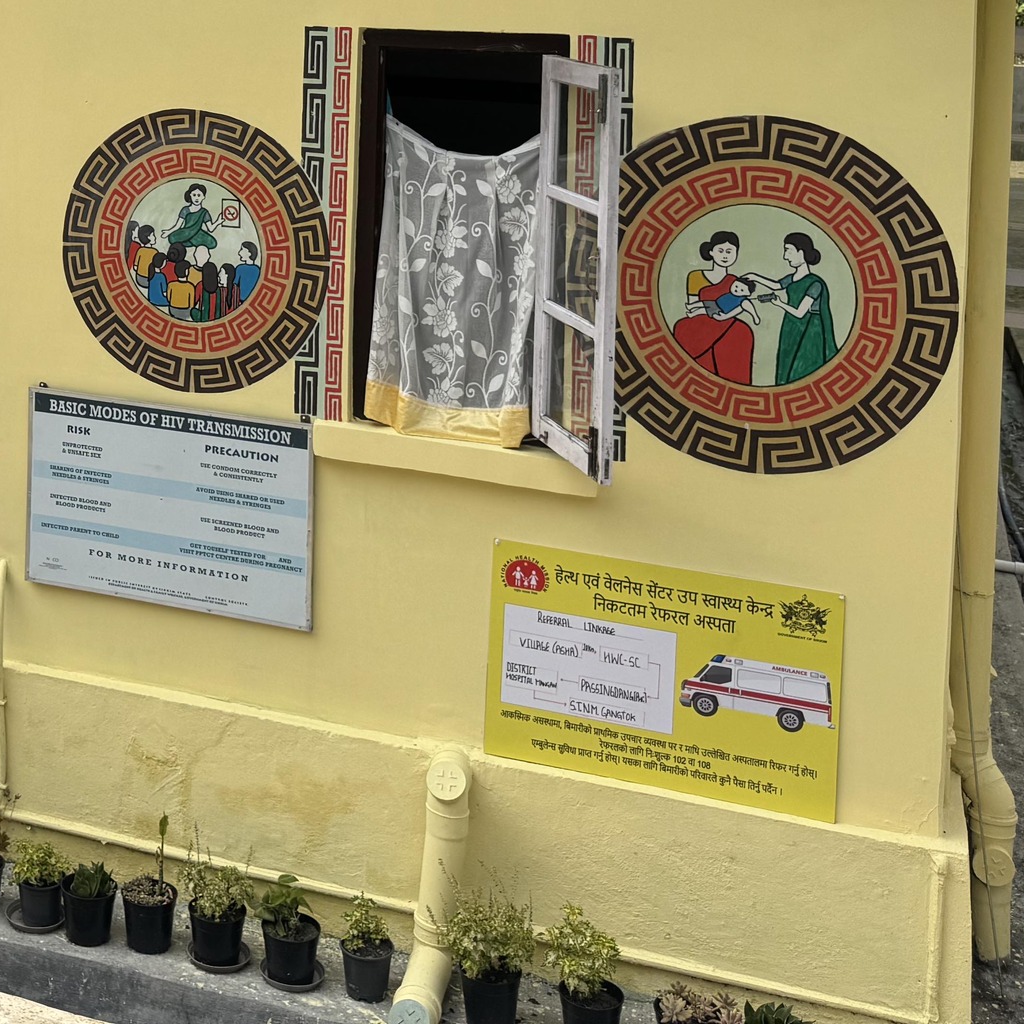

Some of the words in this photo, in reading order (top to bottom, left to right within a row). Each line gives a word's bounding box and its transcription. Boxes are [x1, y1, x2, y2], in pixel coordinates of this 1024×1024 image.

[49, 399, 87, 416] BASIC
[89, 404, 136, 423] MODES
[139, 411, 158, 427] OF
[161, 414, 185, 429] HIV
[187, 418, 292, 445] TRANSMISSION
[67, 424, 91, 436] RISK
[62, 441, 103, 452] UNPROTECTED
[67, 449, 90, 457] UNSAFE
[205, 444, 279, 463] PRECAUTION
[49, 464, 75, 473] SHARING
[83, 469, 112, 479] INFECTED
[52, 471, 77, 480] NEEDLES
[82, 476, 110, 485] SYRINGES
[211, 464, 240, 474] CONDOM
[240, 468, 278, 479] CORRECTLY
[219, 472, 264, 484] CONSISTENTLY
[49, 493, 78, 502] INFECTED
[78, 497, 99, 505] BLOOD
[195, 487, 215, 495] AVOID
[235, 492, 259, 501] SHARED
[55, 501, 76, 509] BLOOD
[76, 504, 106, 513] PRODUCTS
[209, 495, 235, 505] NEEDLES
[242, 501, 271, 510] SYRINGES
[41, 522, 69, 531] INFECTED
[69, 526, 92, 535] PARENT
[211, 519, 243, 528] SCREENED
[244, 524, 266, 532] BLOOD
[213, 526, 236, 534] BLOOD
[236, 529, 266, 539] PRODUCT
[229, 549, 253, 558] TESTED
[88, 548, 112, 559] FOR
[117, 553, 152, 566] MORE
[157, 560, 249, 582] INFORMATION
[215, 553, 240, 562] CENTRE
[240, 557, 267, 567] DURING
[265, 561, 303, 573] PREGNANCY
[500, 558, 514, 588] NATIONAL
[514, 555, 540, 565] HEALTH
[539, 565, 551, 593] MISSION
[554, 565, 580, 586] हेल्थ
[582, 573, 600, 590] एवं
[603, 572, 643, 597] वेलनेस
[645, 580, 675, 602] सेंटर
[676, 589, 699, 606] उप
[701, 593, 743, 613] स्वास्थ्य
[745, 595, 775, 619] केन्द्र
[593, 593, 647, 618] निकटतम
[650, 602, 690, 626] रेफरल
[693, 614, 736, 634] अस्पता
[583, 621, 616, 636] LINKAGE
[519, 637, 550, 652] VILLAGE
[552, 641, 579, 657] (ASHA)
[506, 661, 536, 676] DISTRICT
[771, 665, 808, 676] AMBULANCE
[505, 672, 533, 685] HOSPITAL
[600, 707, 636, 722] GANGTOK
[620, 733, 642, 744] उपचार
[769, 759, 787, 772] रिफर
[673, 756, 686, 765] 102
[688, 758, 696, 766] वा
[697, 760, 711, 769] 108
